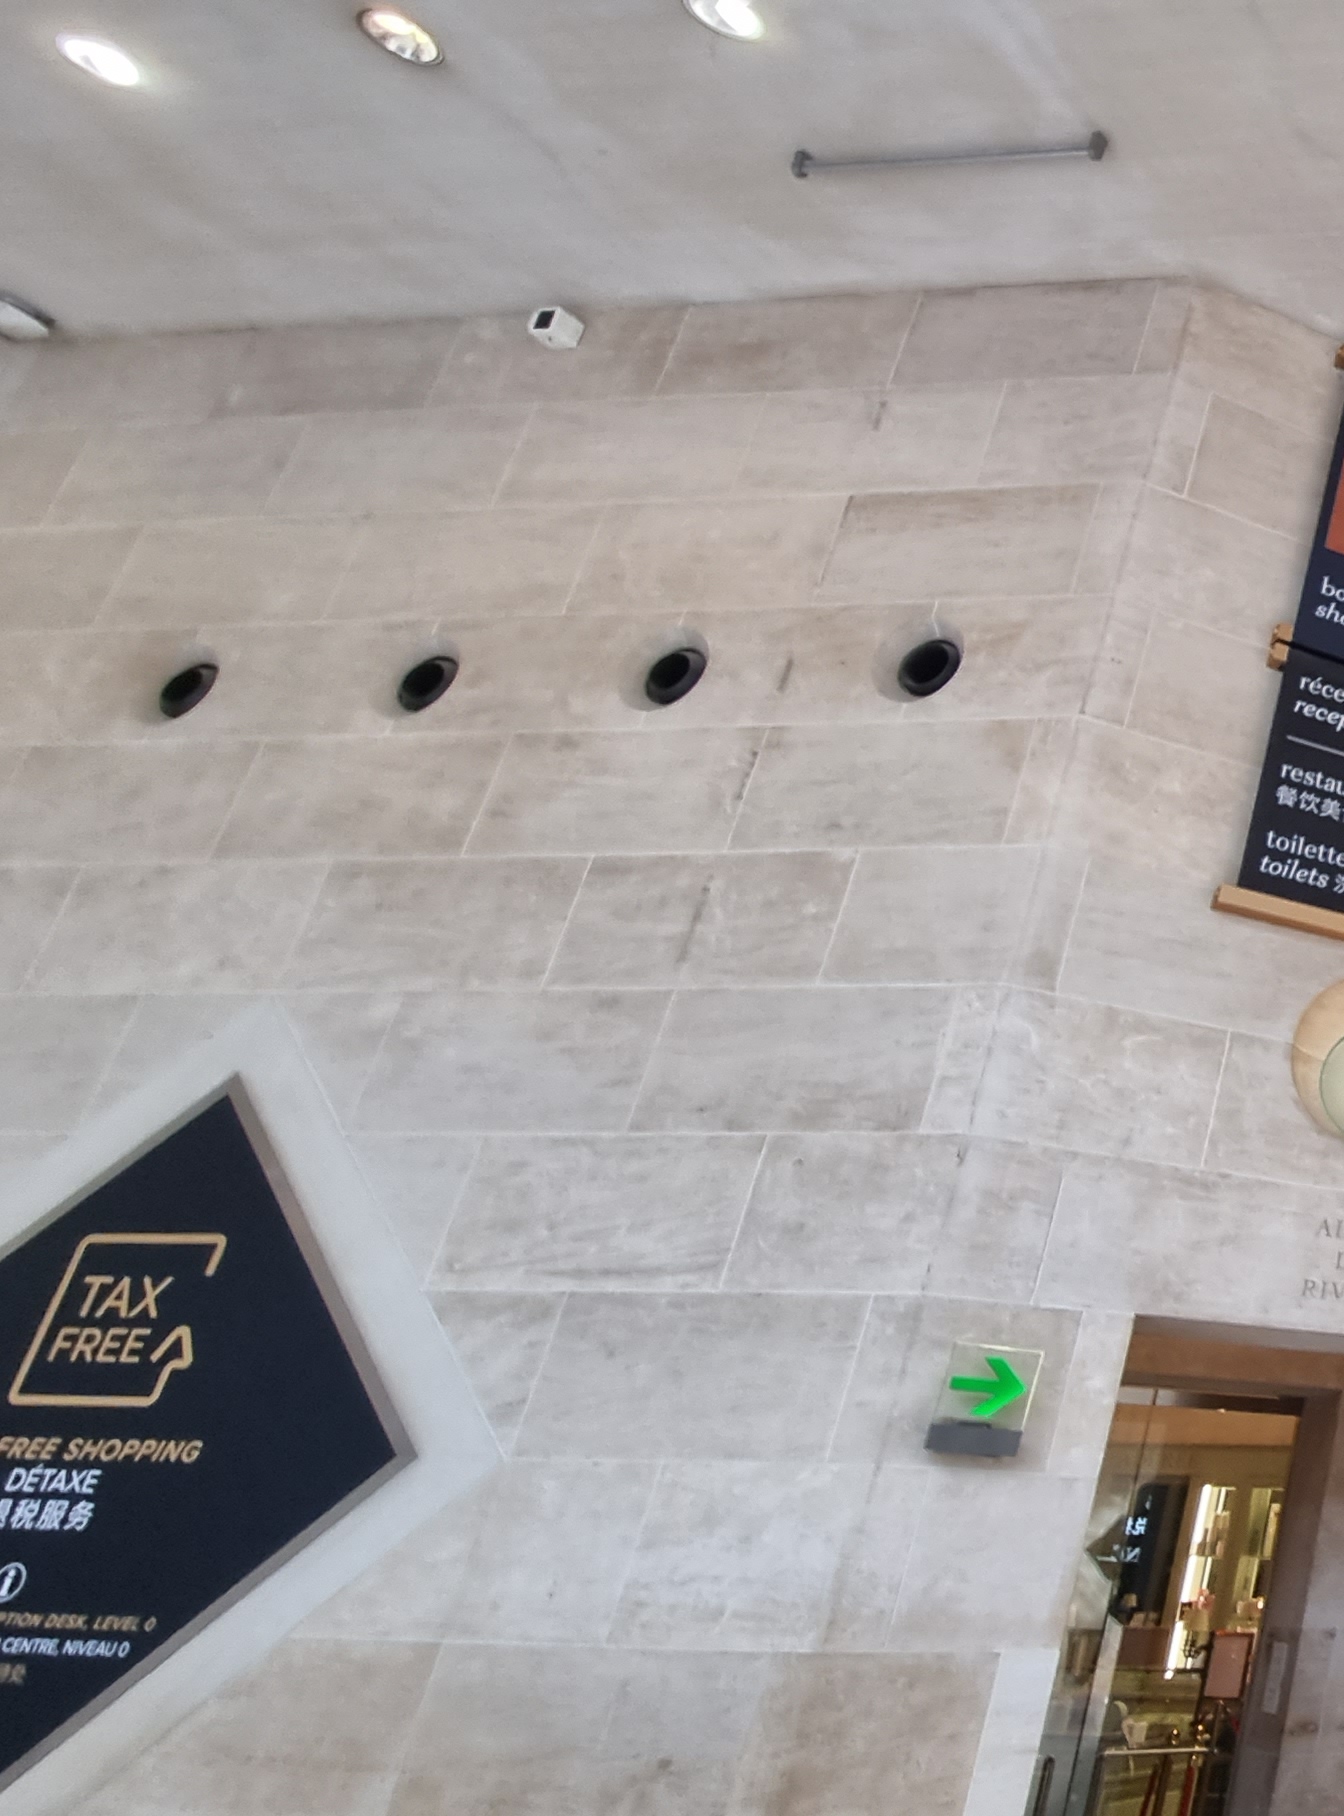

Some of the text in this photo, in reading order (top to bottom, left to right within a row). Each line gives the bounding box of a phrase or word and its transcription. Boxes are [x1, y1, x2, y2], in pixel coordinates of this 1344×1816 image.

[1259, 855, 1329, 889] toilets
[79, 1275, 174, 1318] TAX
[47, 1328, 152, 1364] FREE
[0, 1436, 204, 1464] FREE SHOPPING
[4, 1462, 103, 1494] DÉTAXE
[93, 1615, 140, 1632] LEVEL
[62, 1639, 117, 1658] NIVEAU
